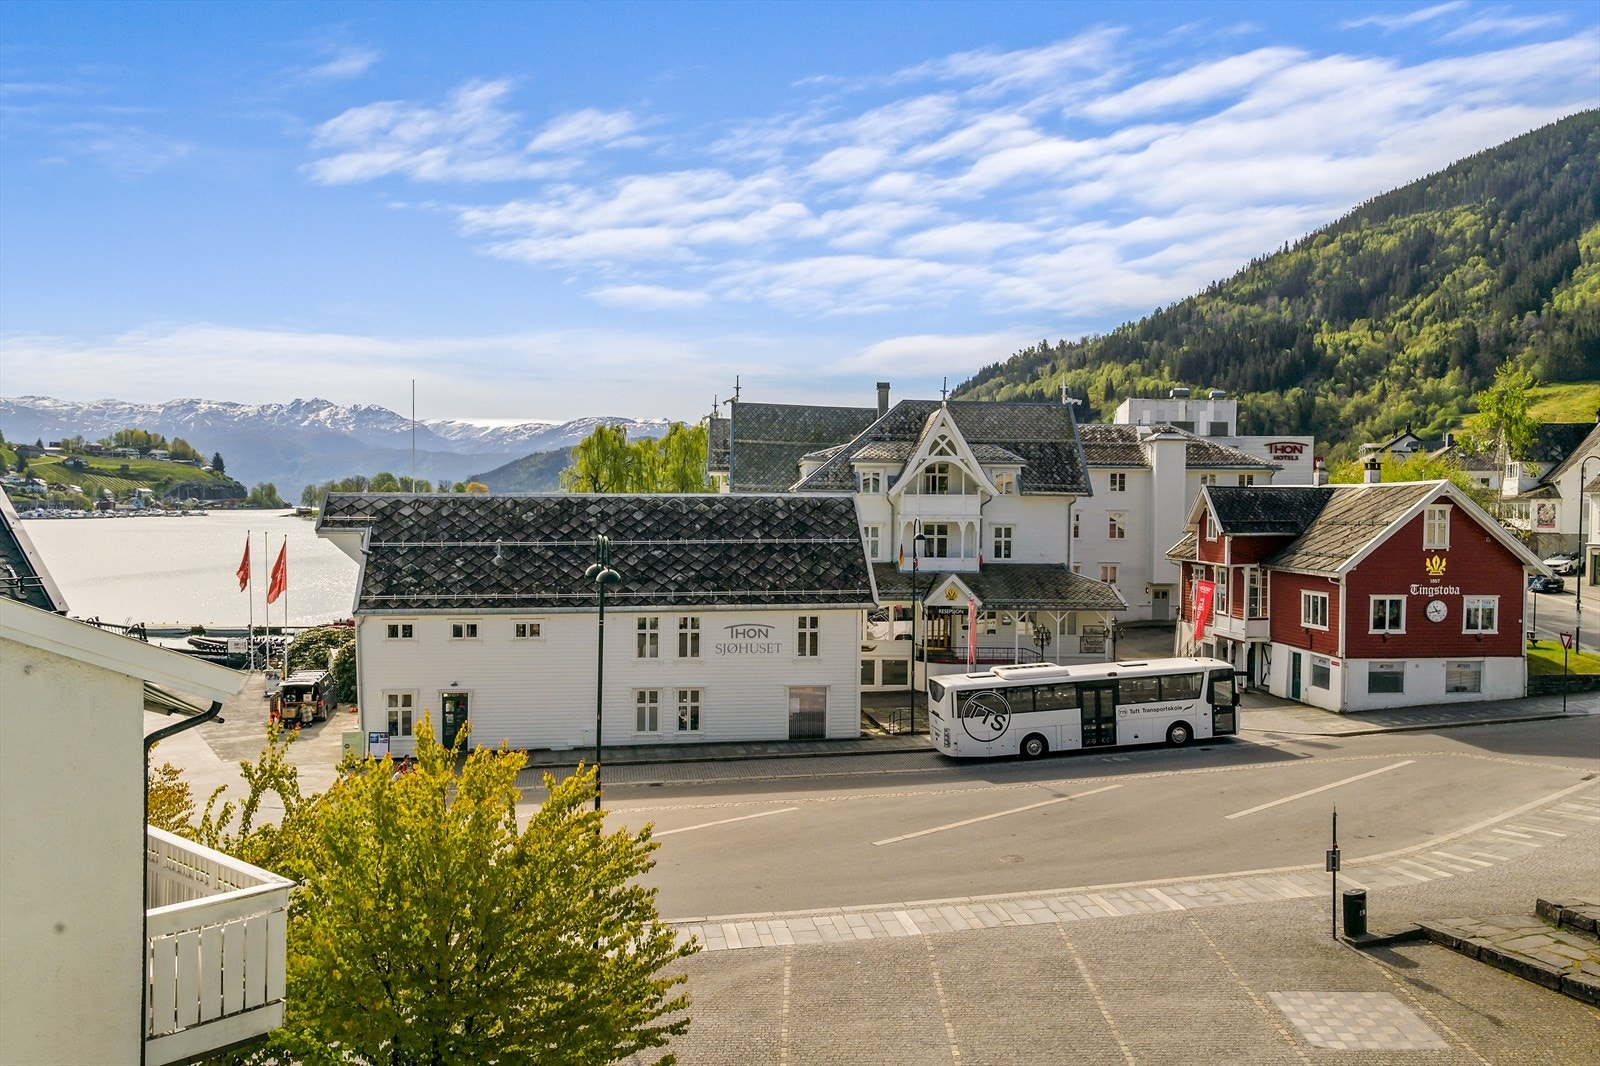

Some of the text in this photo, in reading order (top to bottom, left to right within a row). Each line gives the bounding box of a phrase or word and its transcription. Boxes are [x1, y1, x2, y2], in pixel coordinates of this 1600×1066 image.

[1264, 442, 1309, 454] THON
[1410, 584, 1460, 597] Tingstova
[724, 623, 775, 639] THON
[715, 643, 782, 656] SJØHUSET
[970, 700, 1006, 731] TTS
[1142, 705, 1182, 713] Transportskole
